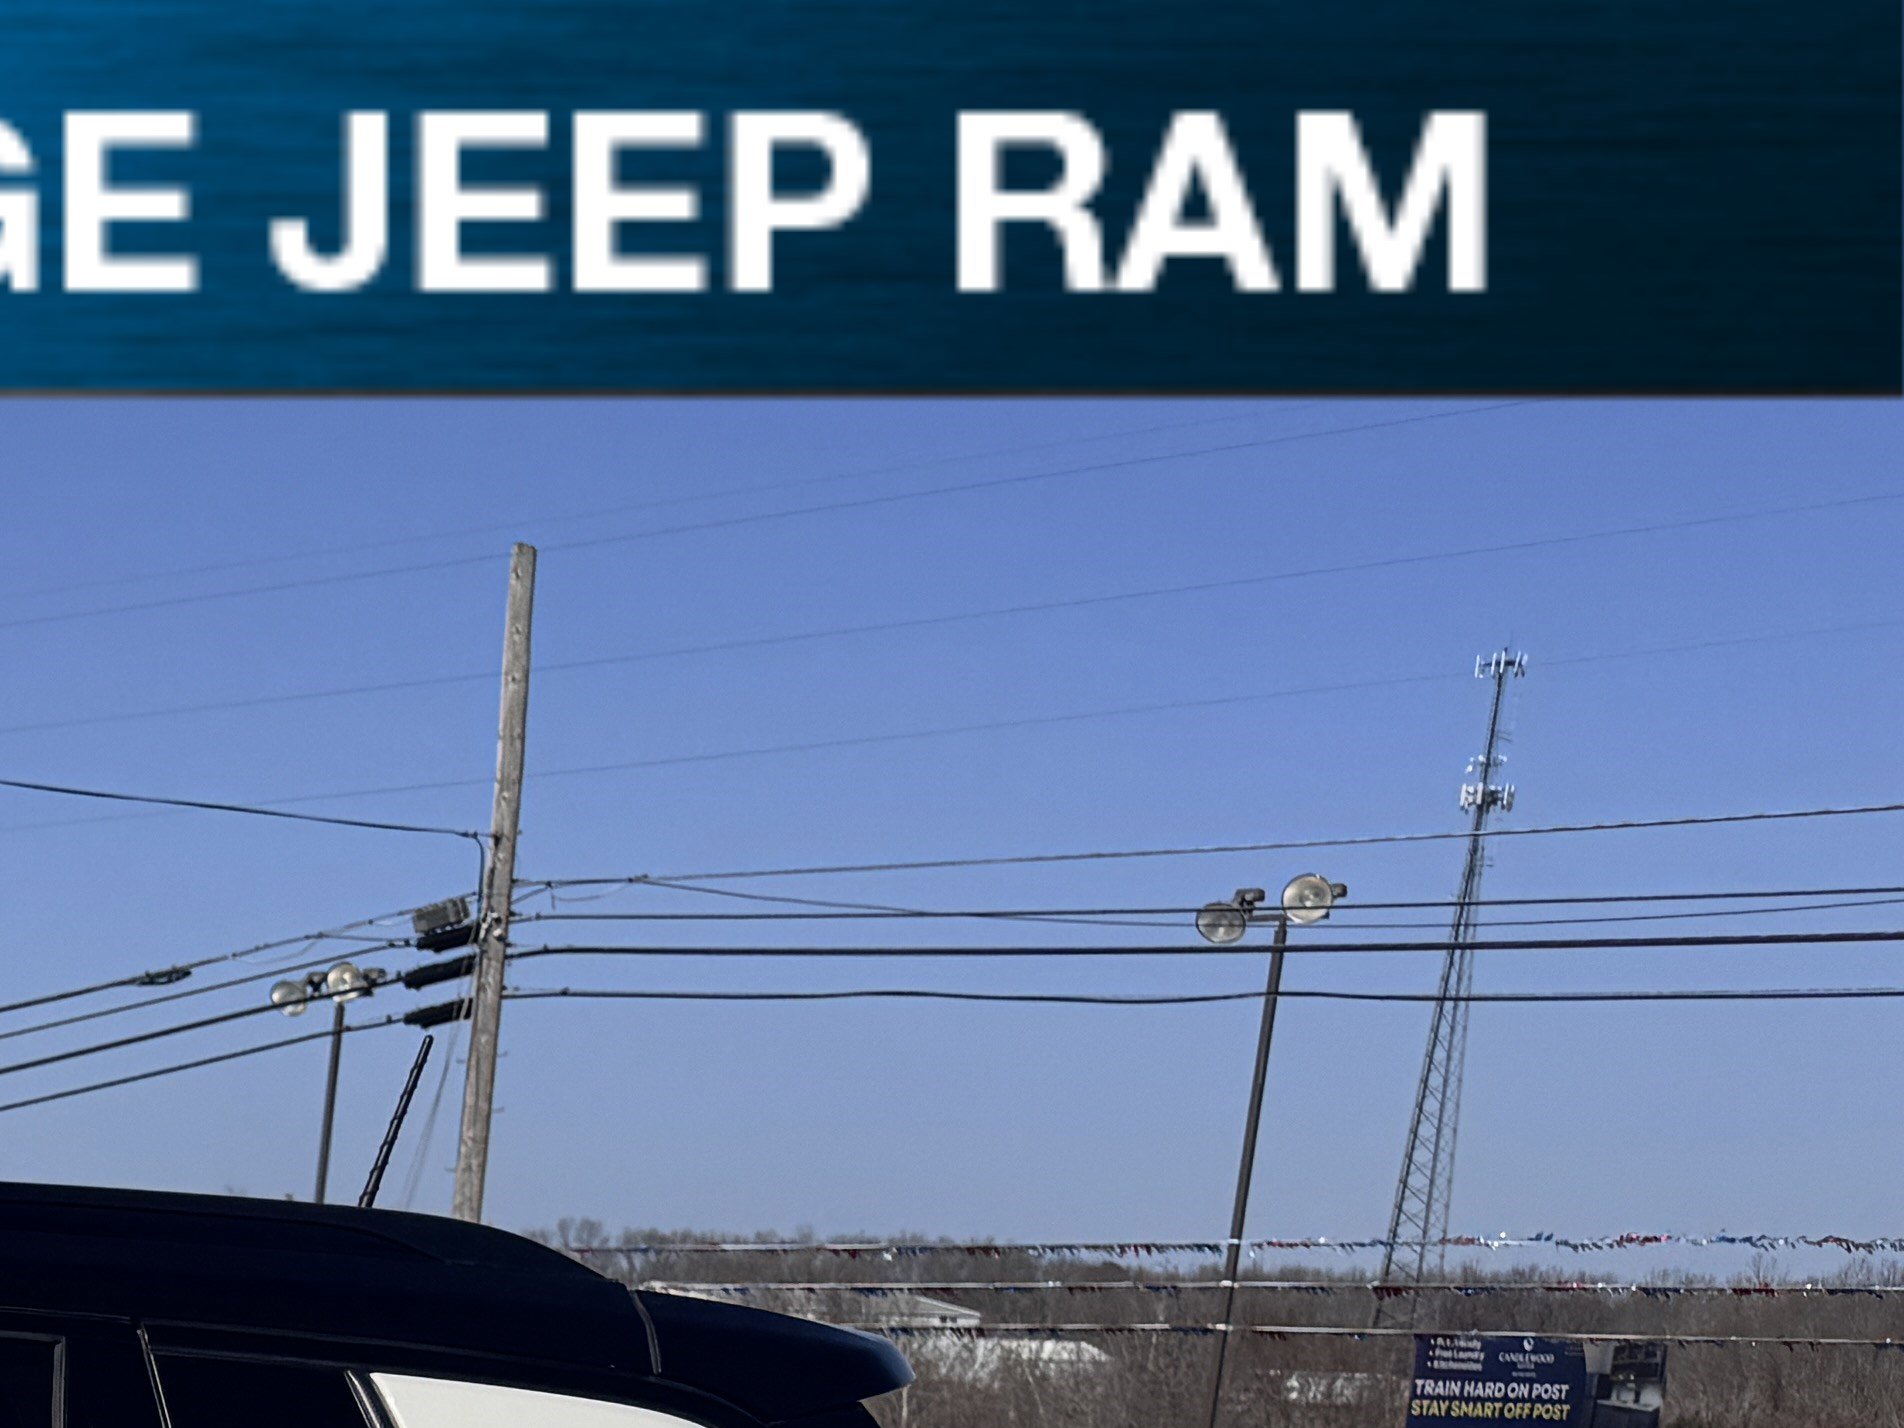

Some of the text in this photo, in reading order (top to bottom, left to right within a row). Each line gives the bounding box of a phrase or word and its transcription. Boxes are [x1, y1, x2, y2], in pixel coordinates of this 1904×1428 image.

[1414, 1378, 1570, 1399] TRAIN HARD ON POST
[1410, 1399, 1571, 1421] STAY SMART OFF POST
